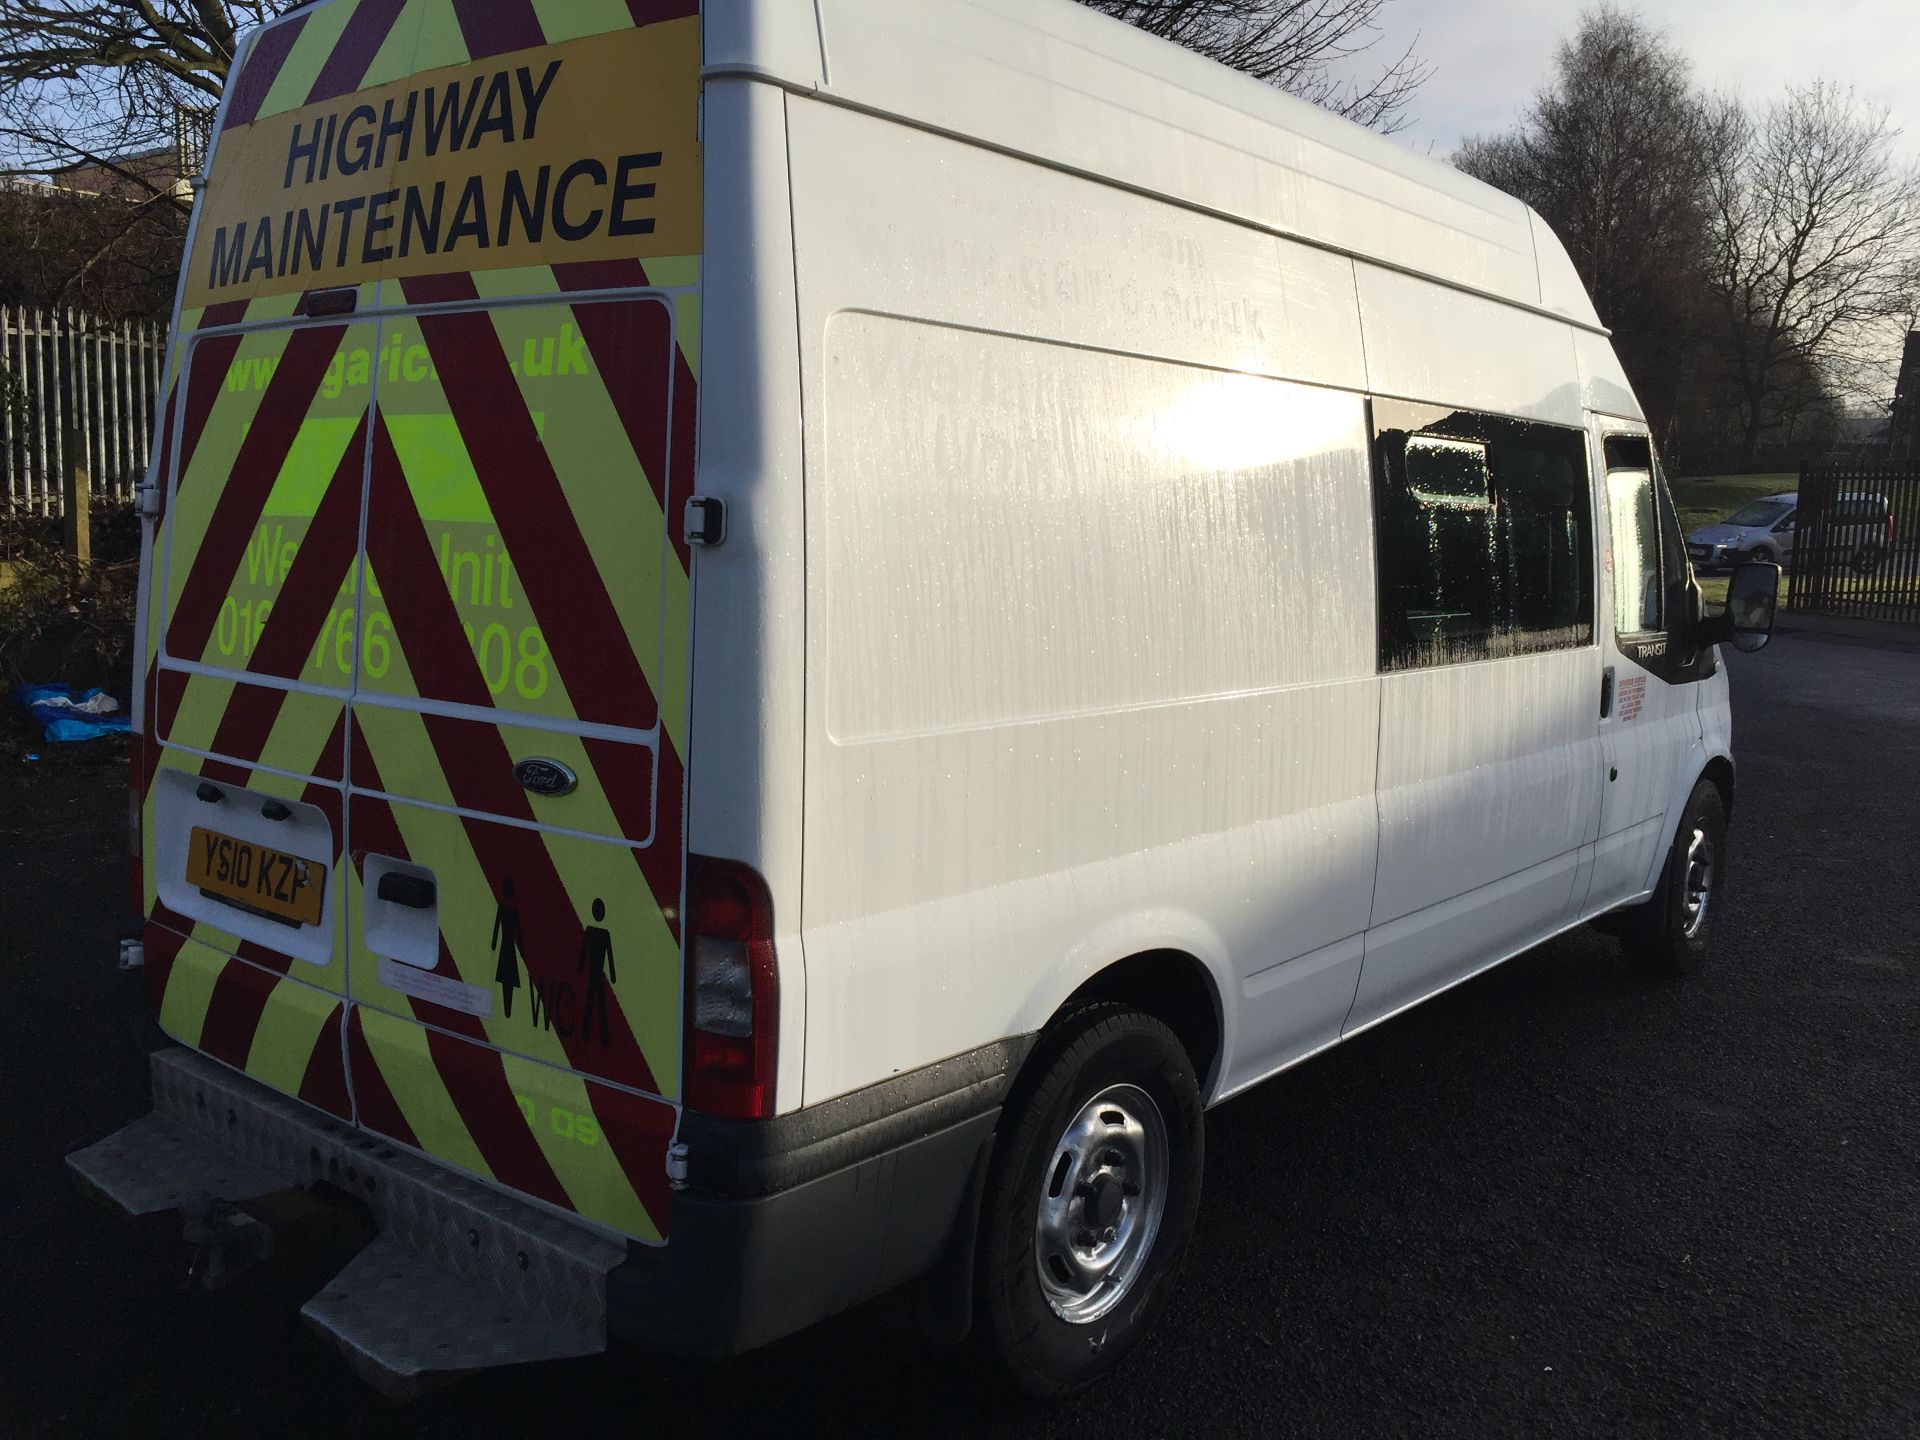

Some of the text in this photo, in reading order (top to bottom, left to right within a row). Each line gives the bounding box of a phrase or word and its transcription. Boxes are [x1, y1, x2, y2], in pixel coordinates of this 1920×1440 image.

[283, 60, 563, 189] HIGHWAY
[208, 151, 663, 290] MAINTENANCE
[1637, 642, 1667, 658] TRANSIT
[522, 764, 559, 788] Ford
[205, 833, 252, 889] YS10
[528, 974, 576, 1037] WC
